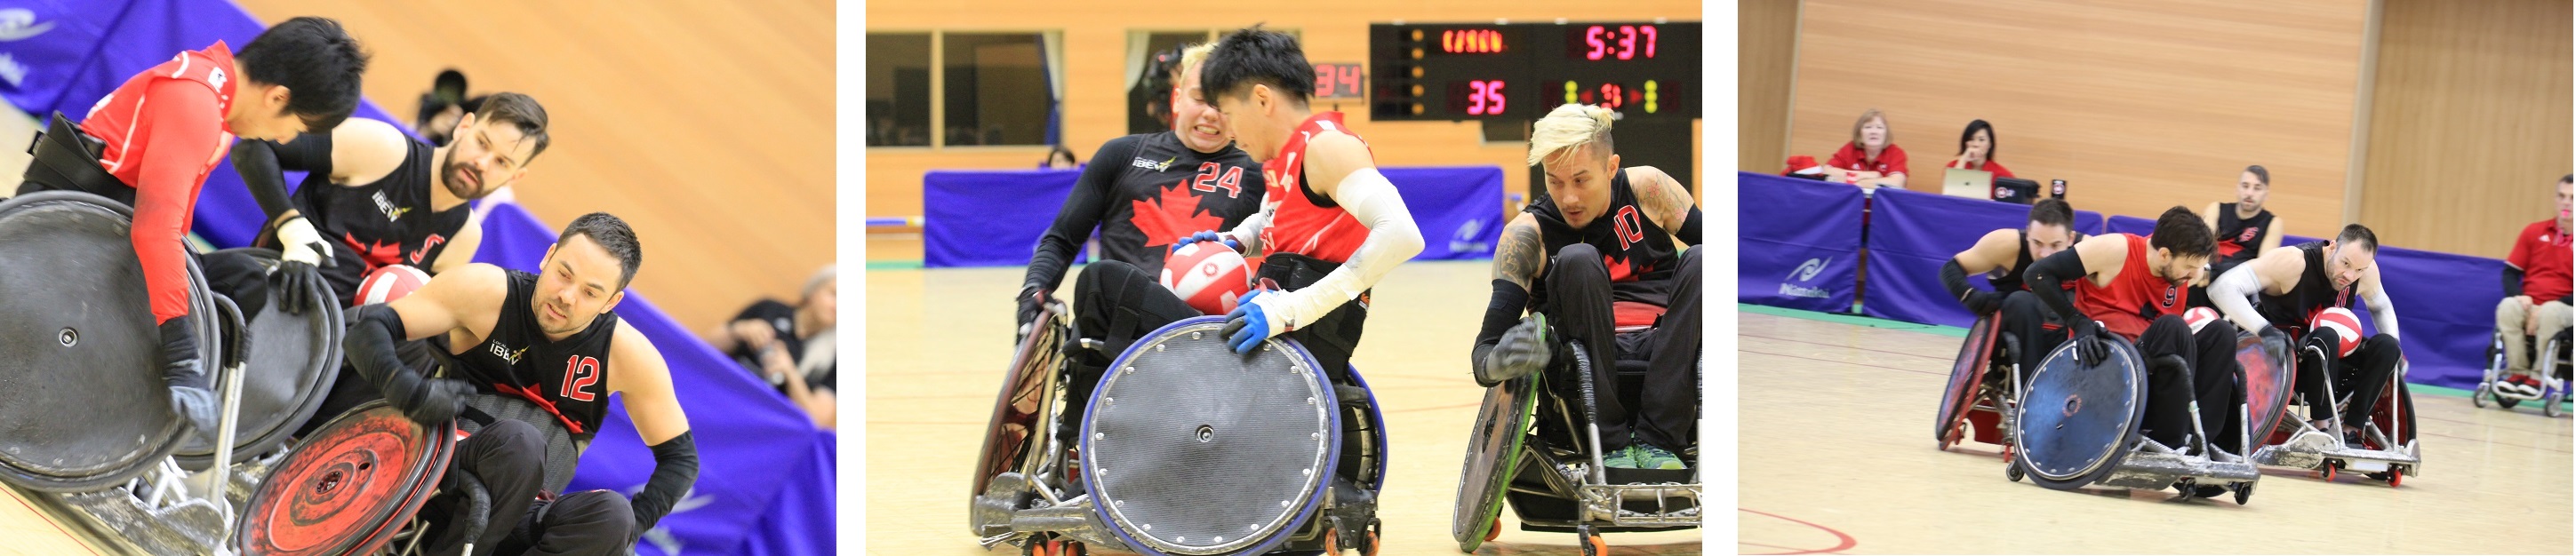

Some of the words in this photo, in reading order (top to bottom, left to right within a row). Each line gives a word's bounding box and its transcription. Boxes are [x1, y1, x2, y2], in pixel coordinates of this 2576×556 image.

[1586, 25, 1658, 60] 5:37
[1315, 63, 1361, 98] 34
[1467, 80, 1506, 115] 35
[1192, 161, 1244, 199] 24
[1613, 204, 1644, 251] 10
[2162, 285, 2178, 308] 9
[2335, 285, 2350, 308] 11
[560, 353, 600, 402] 12
